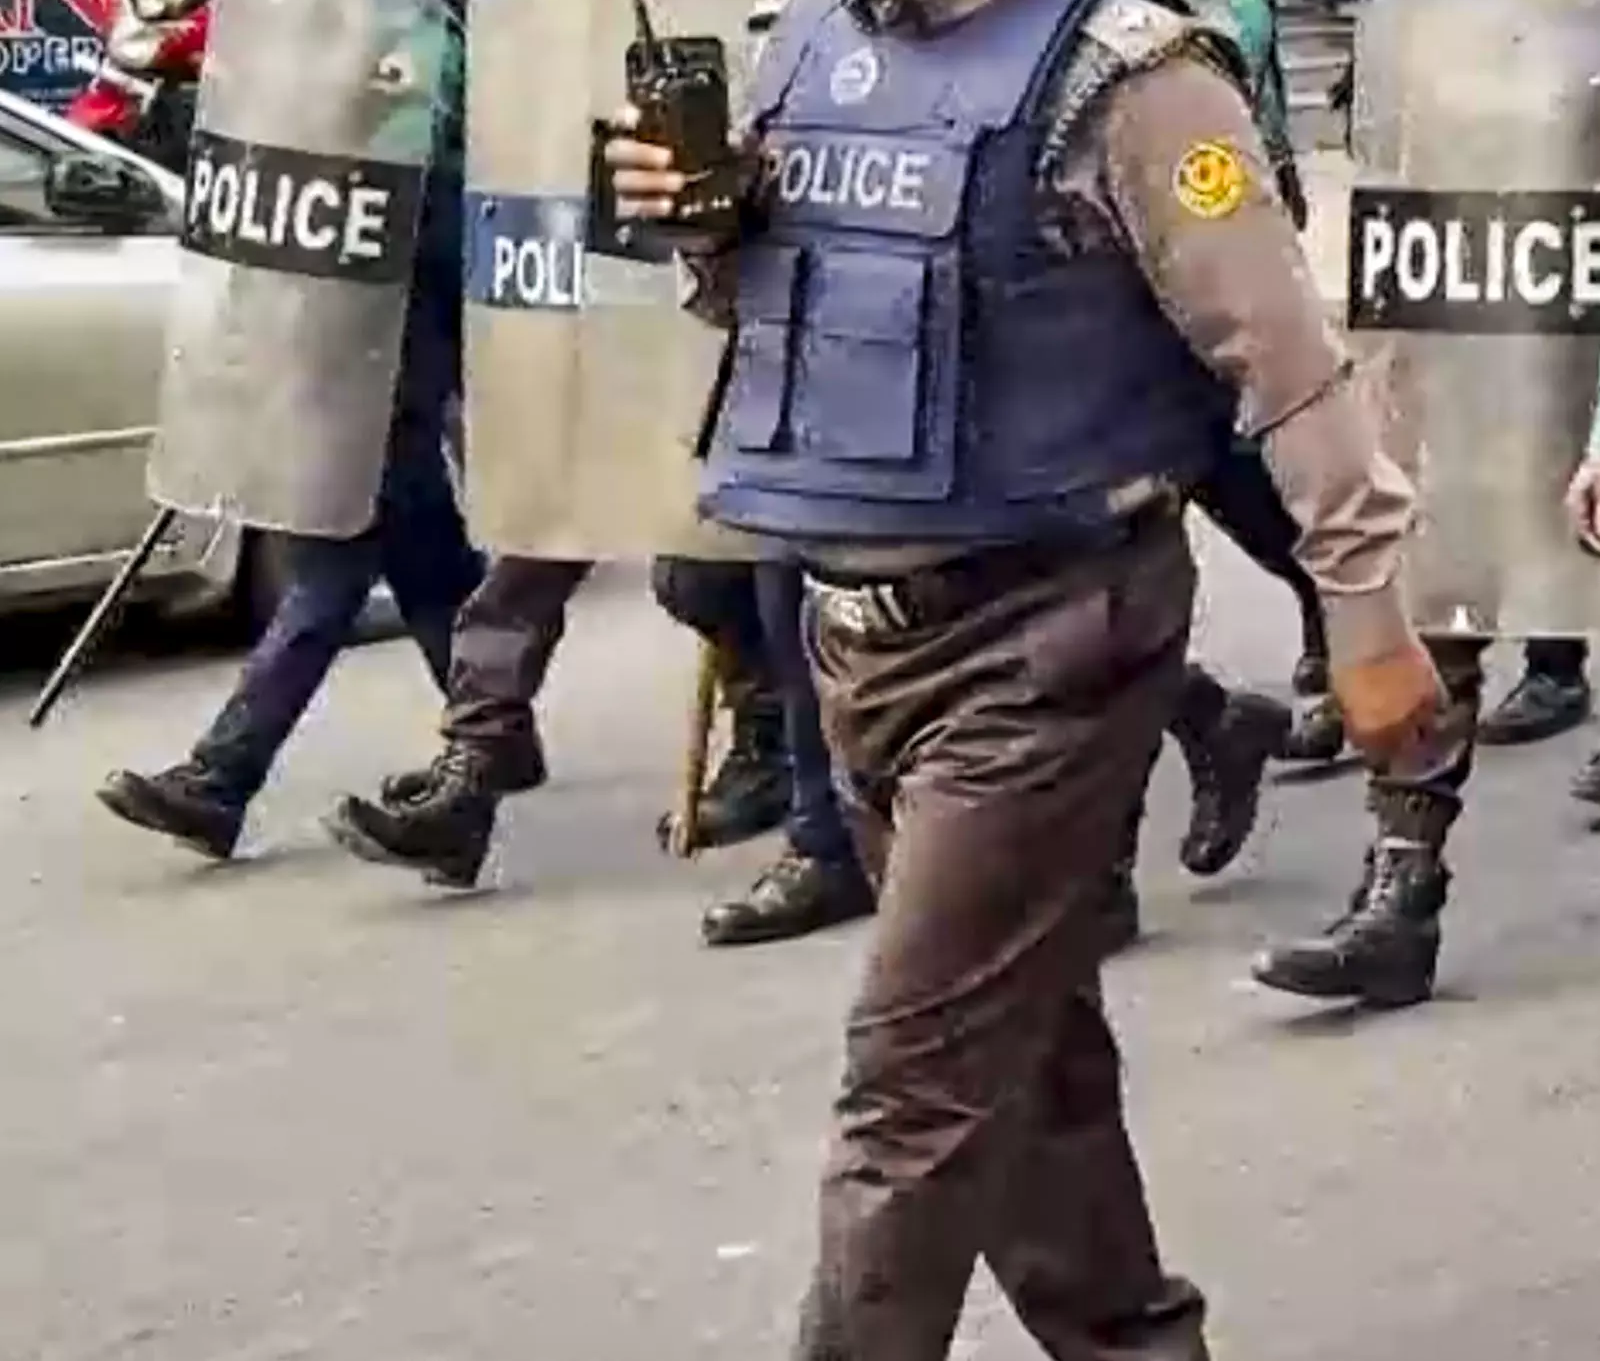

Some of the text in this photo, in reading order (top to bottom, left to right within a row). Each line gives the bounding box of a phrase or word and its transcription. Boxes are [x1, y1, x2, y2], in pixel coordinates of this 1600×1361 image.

[190, 159, 390, 259] POLICE
[766, 147, 931, 210] POLICE
[493, 234, 587, 307] POLI
